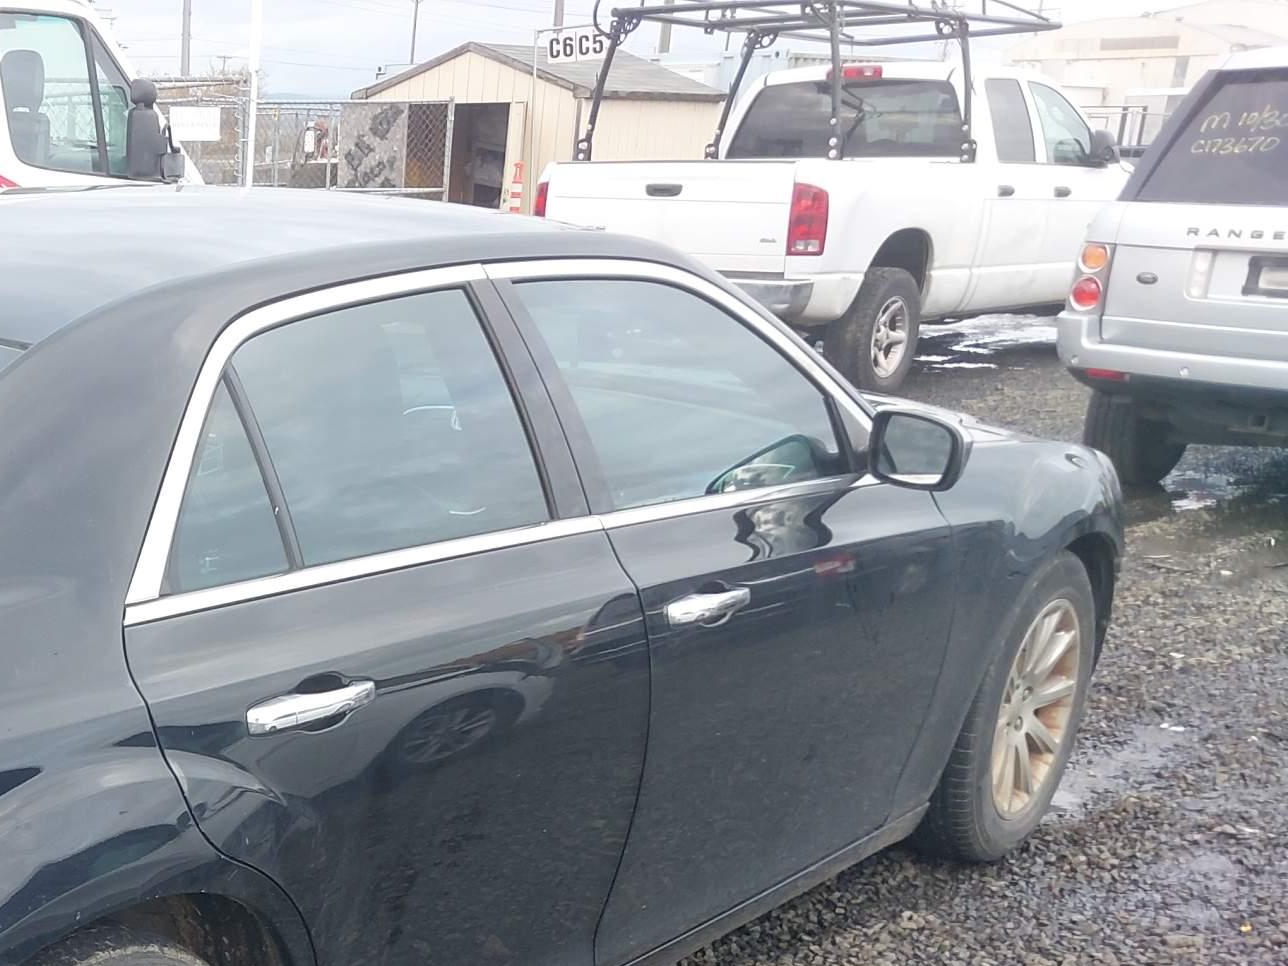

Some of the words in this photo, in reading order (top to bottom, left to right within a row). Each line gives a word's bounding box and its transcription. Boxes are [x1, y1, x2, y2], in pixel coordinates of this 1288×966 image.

[549, 36, 574, 59] C6
[578, 33, 604, 56] C5
[1186, 227, 1287, 241] RANGE
